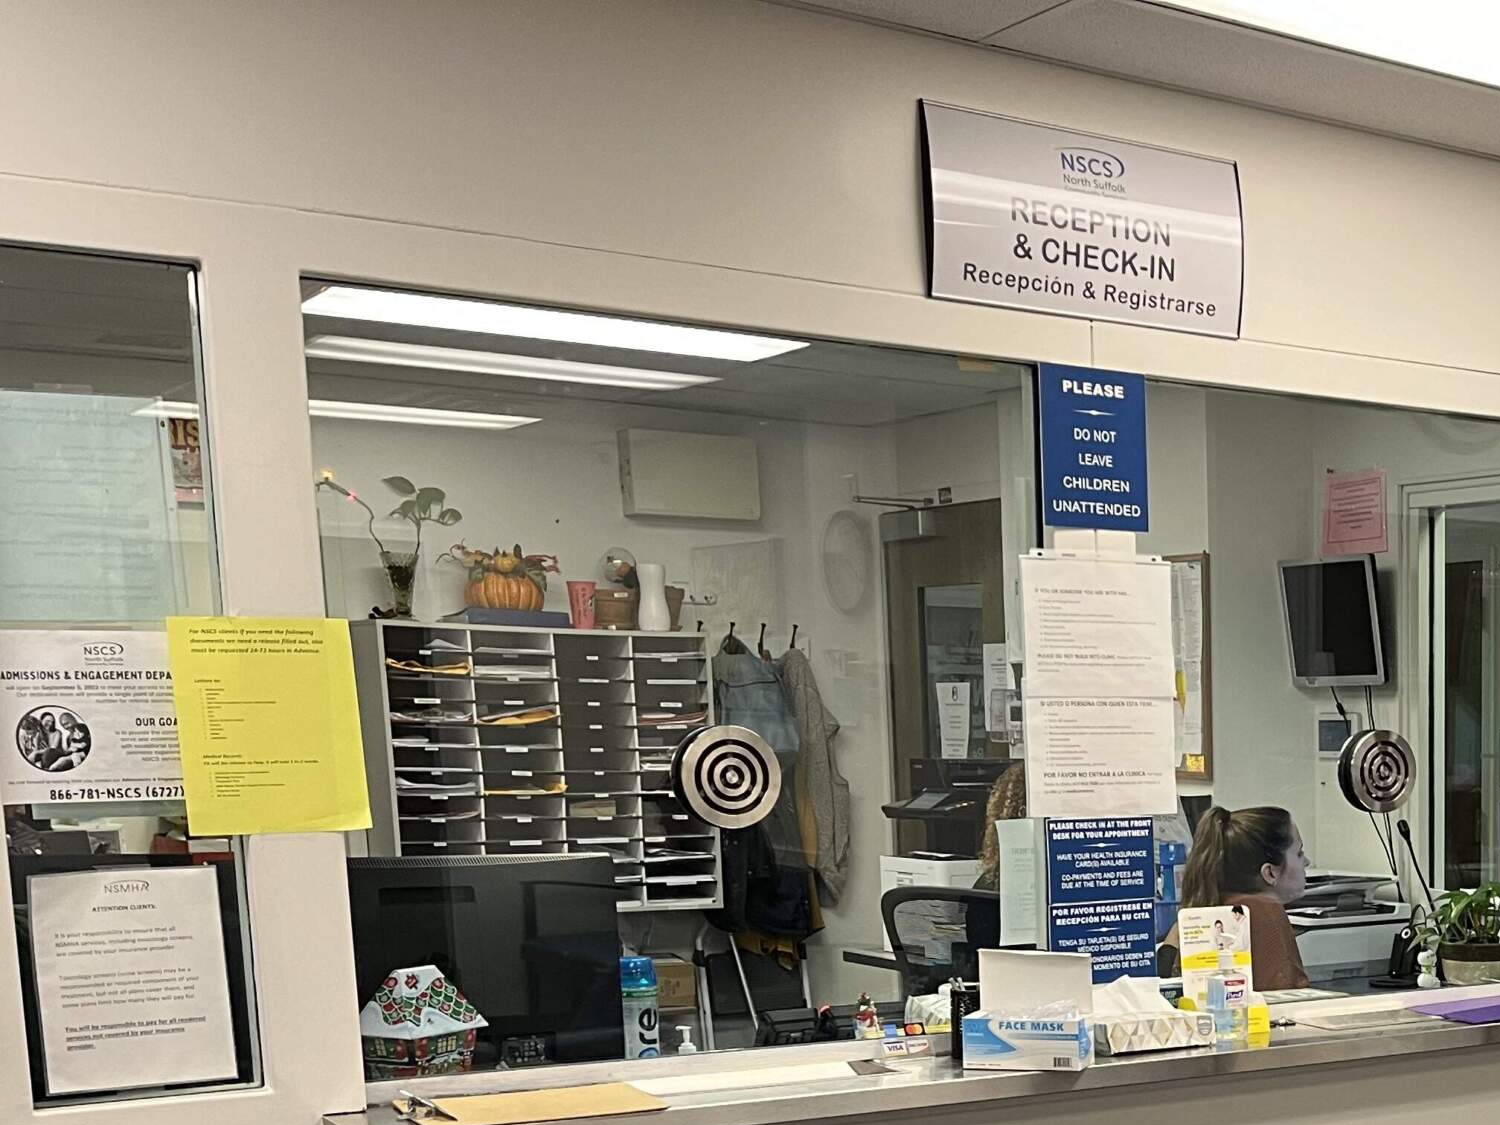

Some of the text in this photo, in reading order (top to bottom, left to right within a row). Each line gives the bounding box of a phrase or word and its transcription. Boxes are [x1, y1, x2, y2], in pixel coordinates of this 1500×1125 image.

[1061, 152, 1113, 178] NSCS
[1063, 174, 1127, 193] North Suffolk
[1011, 196, 1171, 247] RECEPTION
[1013, 233, 1175, 282] & CHECK-IN
[963, 262, 1216, 317] Recepción & Registrarse
[1062, 379, 1125, 399] PLEASE
[1073, 427, 1116, 443] DO NOT
[1078, 452, 1113, 468] LEAVE
[1062, 475, 1130, 493] CHILDREN
[1052, 499, 1141, 517] UNATTENDED
[84, 646, 116, 656] NSCS
[0, 671, 172, 680] ADMISSIONS & ENGAGEMENT DEPA
[136, 718, 178, 726] OUR GOA
[50, 785, 185, 800] 866-781-NSCS (6727)
[1049, 822, 1074, 830] PLEASE
[1075, 821, 1097, 829] CHECK
[1116, 820, 1129, 828] THE
[1130, 819, 1151, 827] FRONT
[1053, 829, 1149, 840] DESK FOR YOUR APPOINTMENT
[1073, 852, 1090, 860] YOUR
[1091, 851, 1113, 859] HEALTH
[1114, 850, 1147, 858] INSURANCE
[1120, 878, 1144, 886] SERVICE
[1052, 908, 1069, 916] POR
[1070, 907, 1094, 915] FAVOR
[1056, 915, 1100, 926] RECEPCIÓN
[1101, 914, 1120, 923] PARA
[1133, 912, 1150, 920] CITA
[1091, 954, 1124, 963] ONORARIOS
[998, 1021, 1064, 1031] FACE MASK
